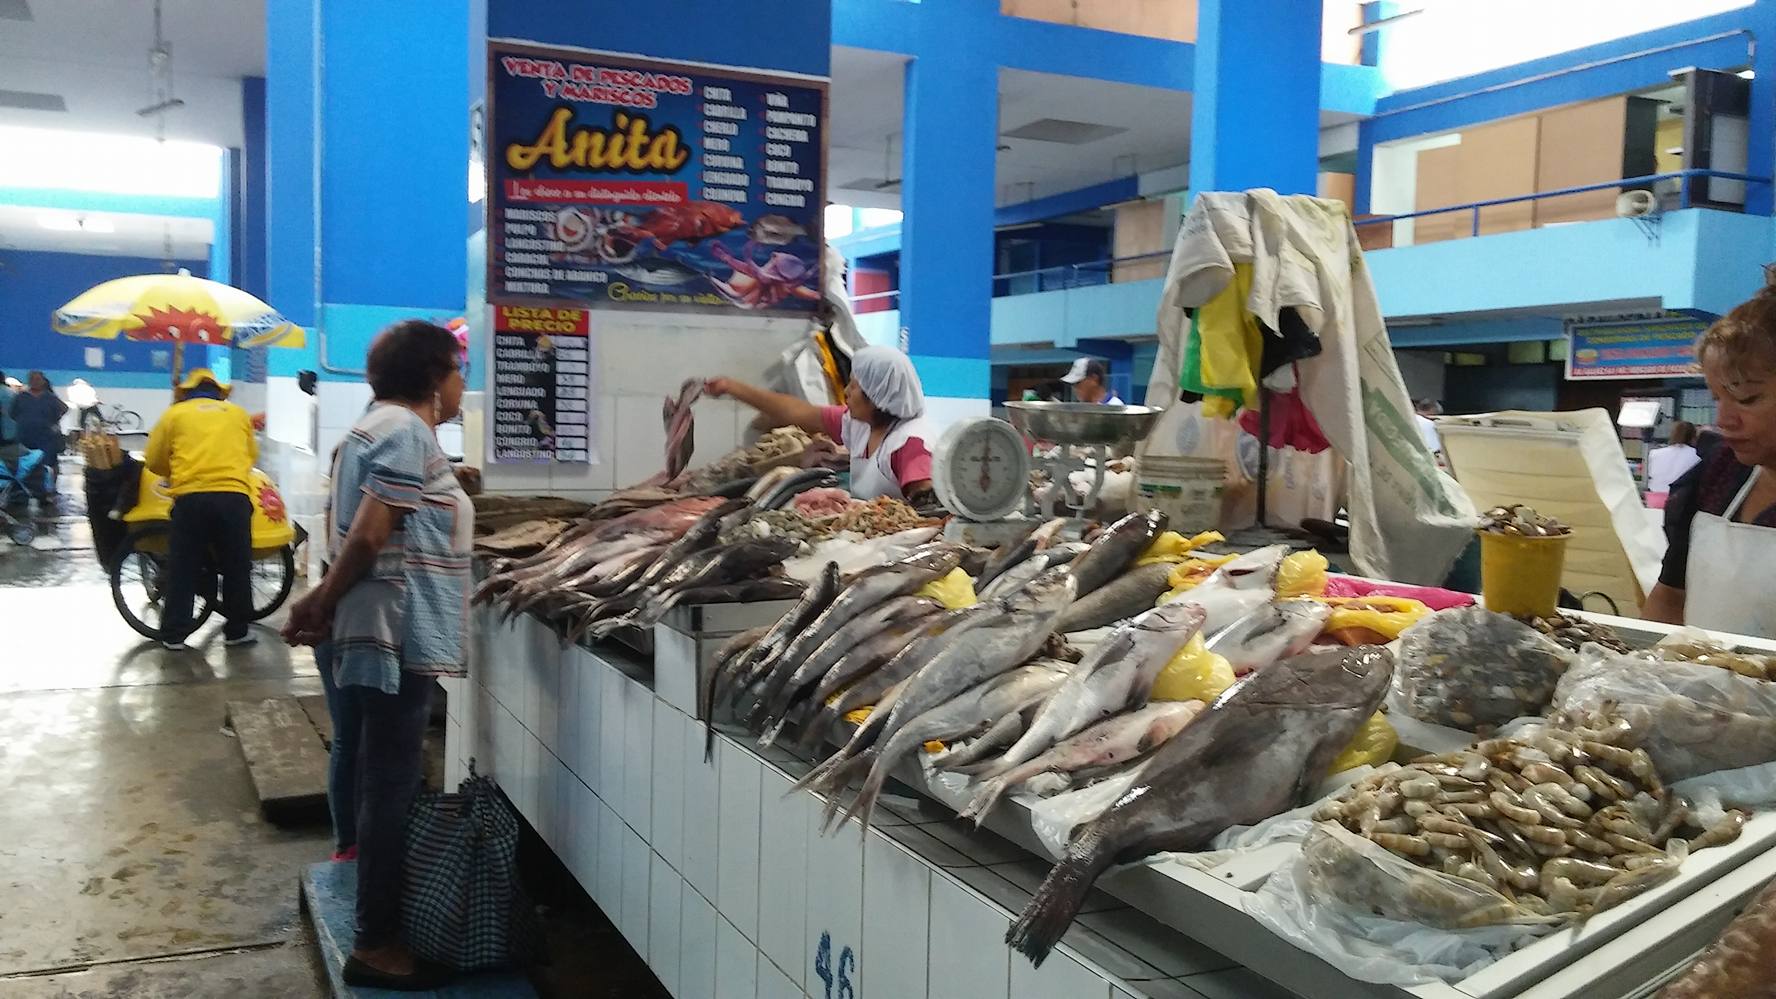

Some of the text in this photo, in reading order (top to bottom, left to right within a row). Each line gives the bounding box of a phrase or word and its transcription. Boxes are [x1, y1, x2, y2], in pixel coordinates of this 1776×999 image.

[501, 56, 693, 96] VENTA DE PESCADOS
[541, 79, 658, 108] Y MARISCOS
[506, 107, 688, 170] Anita
[505, 207, 559, 223] MARISCOS
[505, 222, 537, 236] PULPO
[505, 266, 608, 284] CONCHAS DE ABANICO
[502, 306, 583, 321] LISTA DE
[507, 318, 577, 334] PRECIO
[496, 335, 526, 347] CHITA
[497, 361, 550, 373] TRAMBOYO
[496, 373, 526, 384] MERO
[496, 386, 546, 398] LENGUADO
[496, 411, 524, 422] COCO
[496, 423, 532, 435] BONITO
[496, 436, 539, 448] CONGRIO
[496, 448, 553, 459] LANGOSTINO
